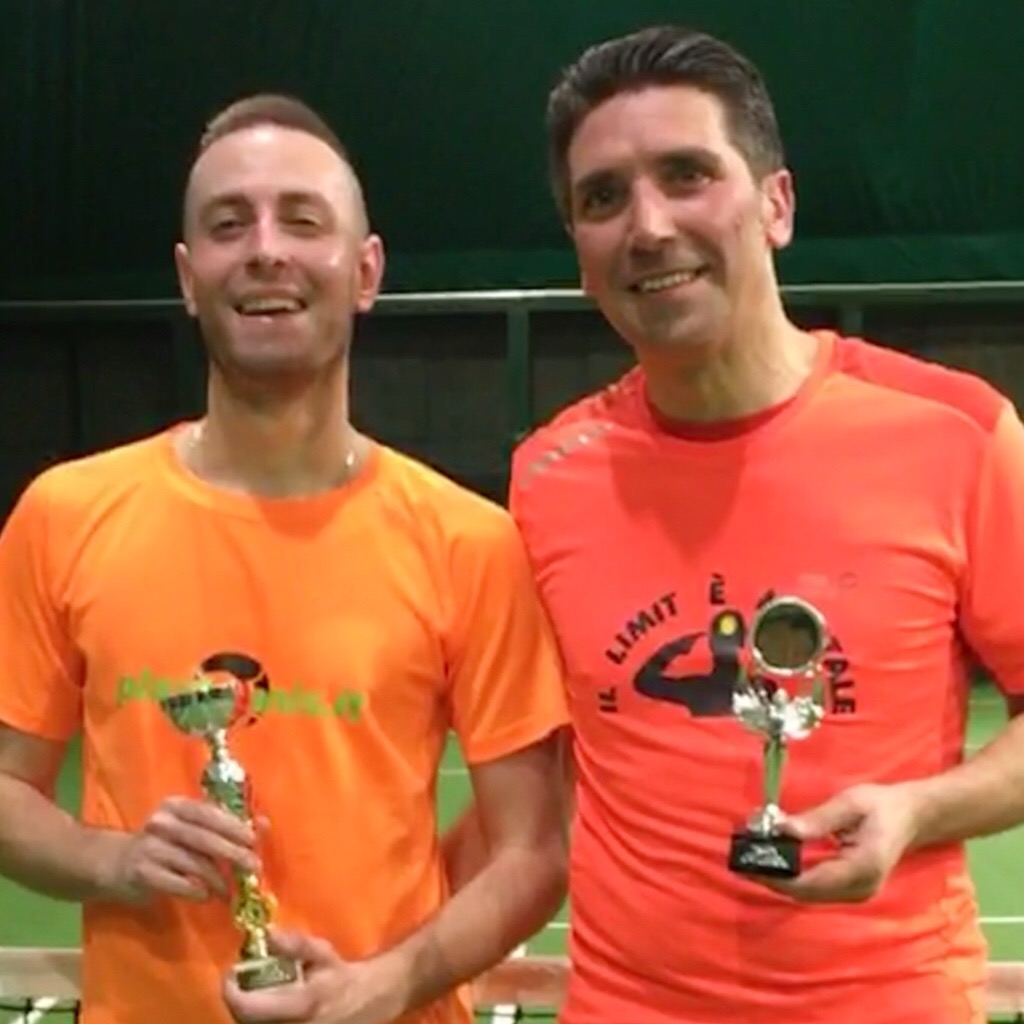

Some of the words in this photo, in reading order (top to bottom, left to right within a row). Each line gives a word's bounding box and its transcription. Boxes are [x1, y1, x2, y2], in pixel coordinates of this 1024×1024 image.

[711, 573, 725, 606] È
[605, 592, 677, 665] LIMIT
[598, 687, 618, 712] IL
